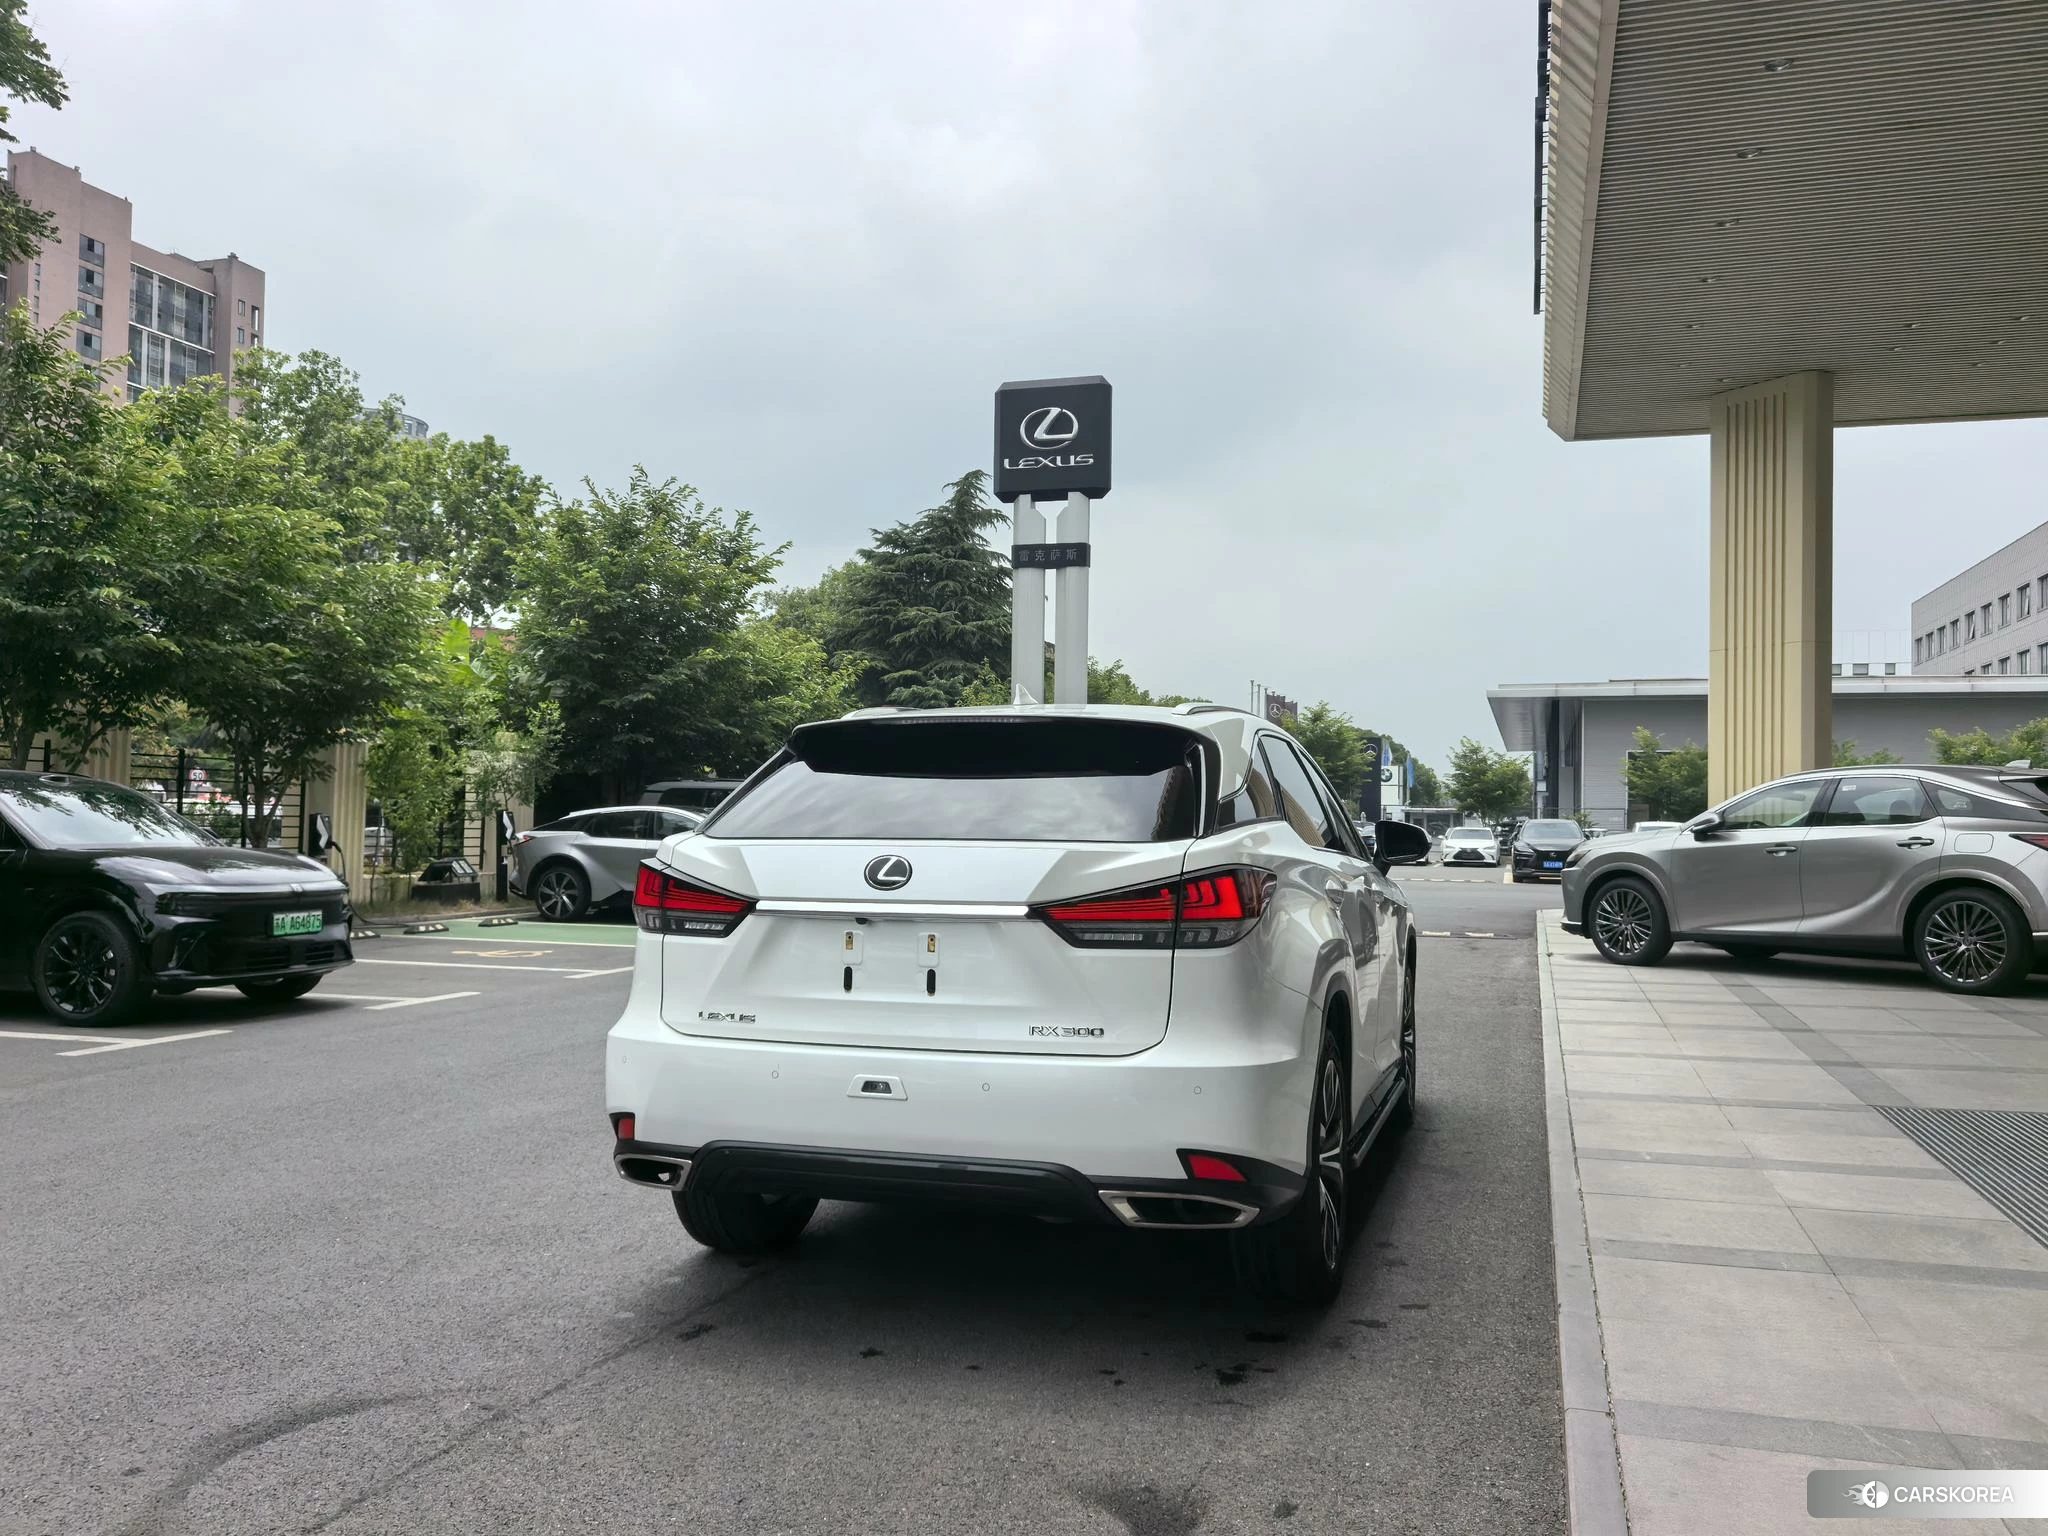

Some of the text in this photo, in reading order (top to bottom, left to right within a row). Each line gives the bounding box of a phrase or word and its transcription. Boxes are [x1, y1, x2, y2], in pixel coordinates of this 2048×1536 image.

[1003, 453, 1094, 470] LEXUS
[1018, 548, 1079, 561] 雷克萨斯
[192, 772, 203, 780] 50
[698, 1011, 756, 1024] LEXUS
[1029, 1025, 1104, 1038] RX 300
